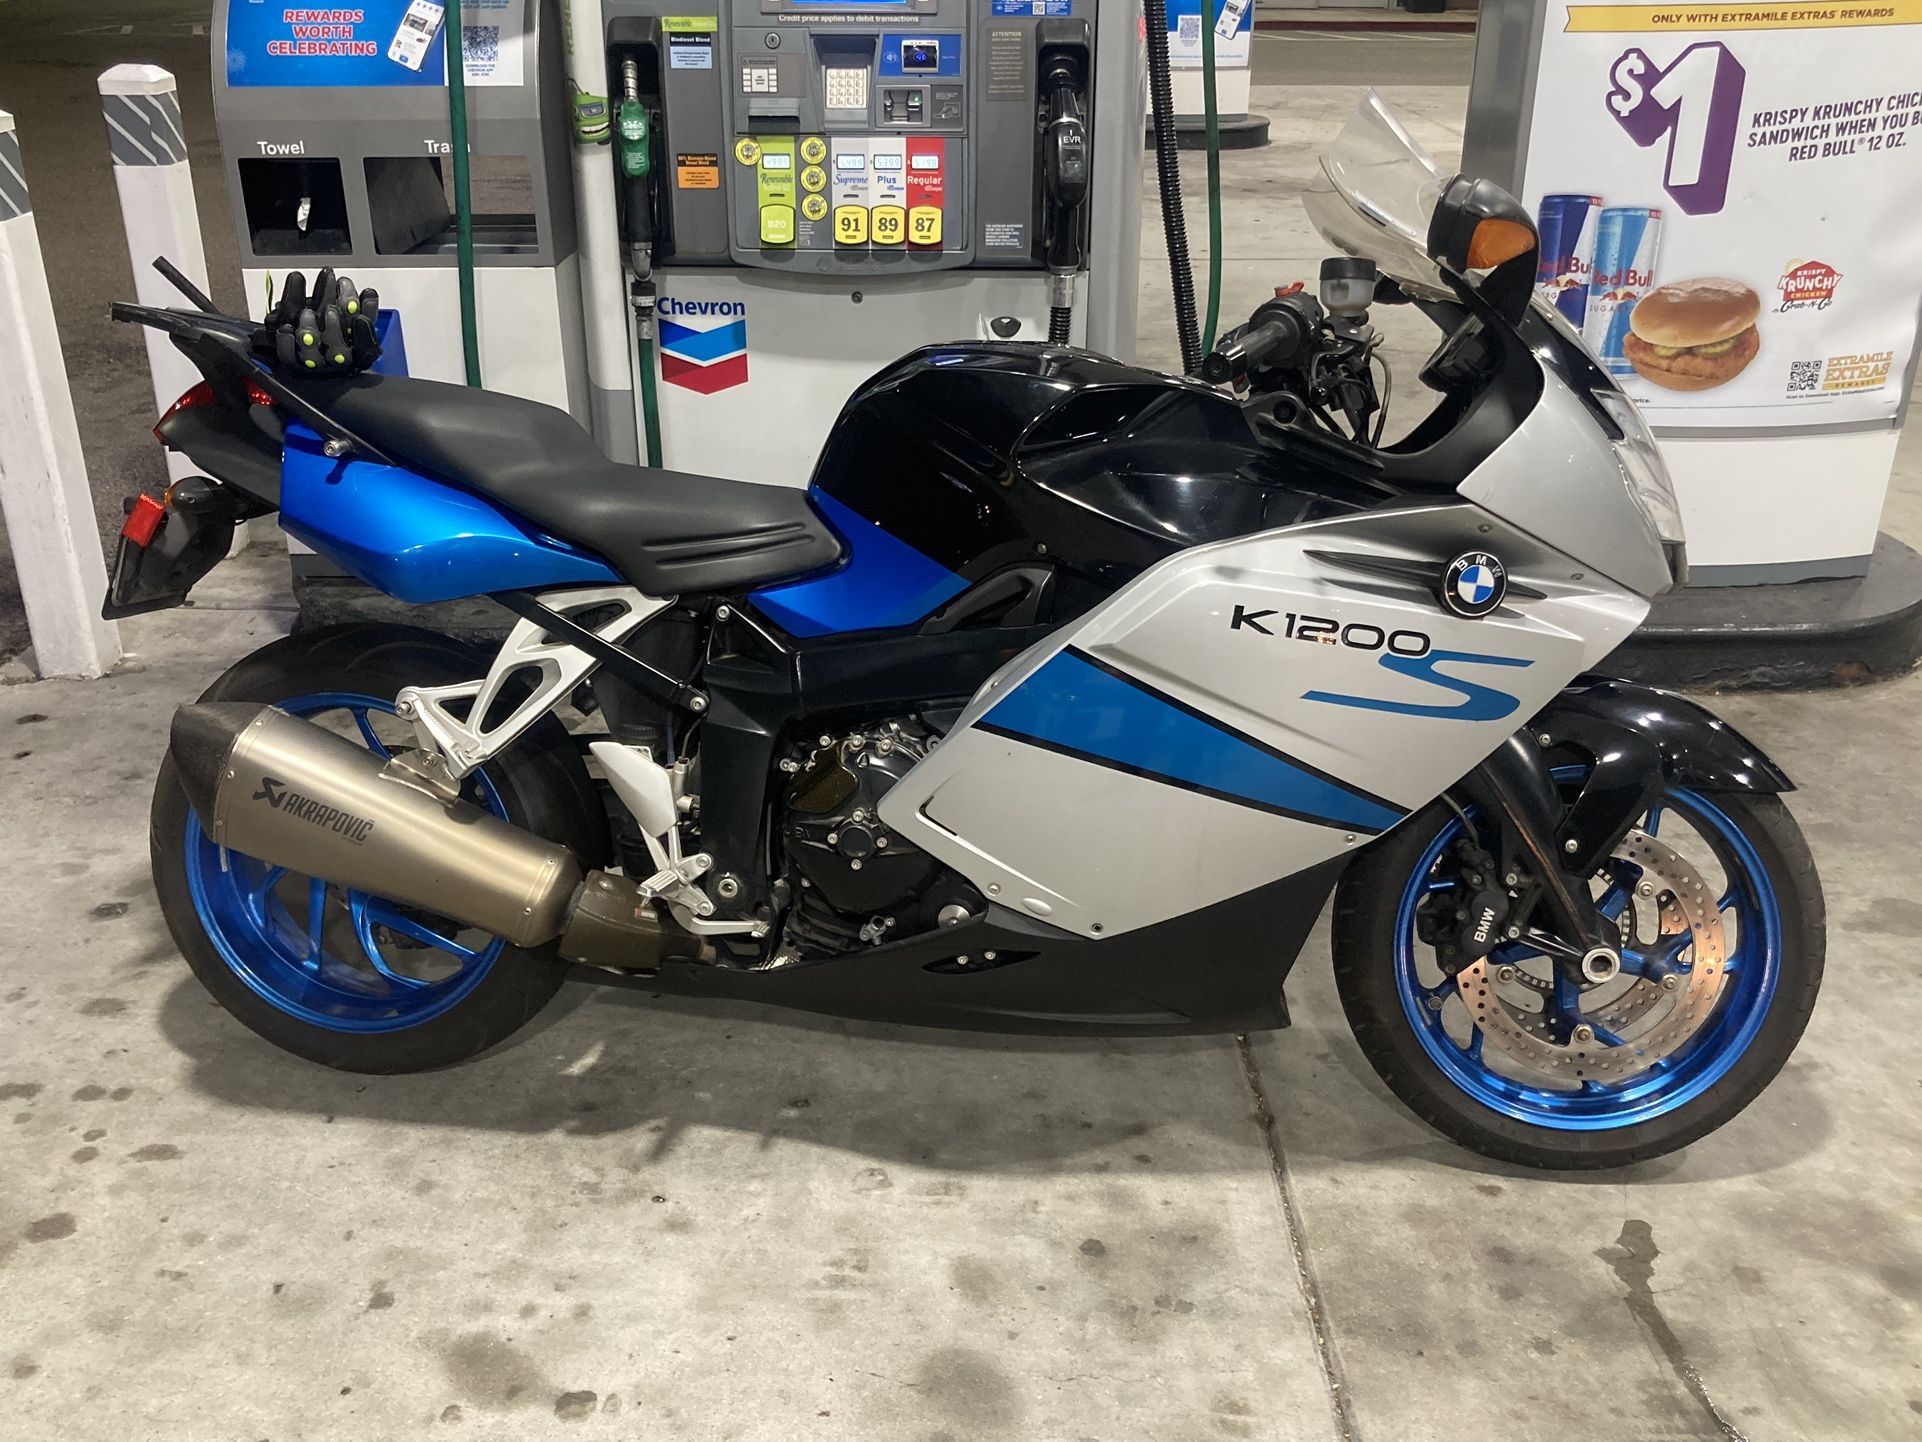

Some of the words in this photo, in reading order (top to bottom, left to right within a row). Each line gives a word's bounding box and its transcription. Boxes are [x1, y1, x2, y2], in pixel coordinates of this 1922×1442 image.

[284, 10, 364, 22] REWARDS
[778, 14, 801, 22] Credit
[802, 15, 819, 23] price
[820, 15, 846, 23] applies
[1651, 14, 1682, 24] ONLY
[1686, 13, 1718, 23] WITH
[1721, 11, 1788, 23] EXTRAMILE
[1840, 8, 1895, 19] REWARDS
[293, 26, 353, 39] WORTH
[267, 41, 378, 56] CELEBRATING
[1752, 107, 1809, 128] KRISPY
[1812, 97, 1884, 121] KRUNCHY
[1606, 42, 1738, 208] $1
[1747, 123, 1831, 147] SANDWICH
[1835, 117, 1877, 137] WHEN
[1882, 112, 1909, 131] YOU
[1911, 110, 1922, 126] B
[424, 140, 471, 153] Tra
[1063, 135, 1082, 144] EVR
[1788, 145, 1818, 162] RED
[1867, 135, 1883, 151] 12
[1885, 132, 1906, 149] OZ.
[257, 140, 305, 155] Towel
[833, 173, 869, 186] Supreme
[877, 175, 896, 184] Plus
[907, 175, 942, 186] Regular
[841, 217, 860, 232] 91
[878, 217, 898, 232] 89
[915, 217, 935, 232] 87
[1592, 267, 1623, 286] Red
[1626, 269, 1653, 287] Bull
[1796, 268, 1827, 276] KRISPY
[1777, 273, 1843, 292] KRUNCHY
[1791, 290, 1827, 299] CHICKEN
[657, 297, 745, 316] Chevron
[1827, 351, 1893, 367] EXTRAMILE
[1824, 362, 1892, 382] EXTRAS
[1453, 554, 1503, 579] BMW
[1230, 604, 1432, 657] K1200
[1299, 648, 1536, 722] S
[1473, 907, 1495, 943] BMW
